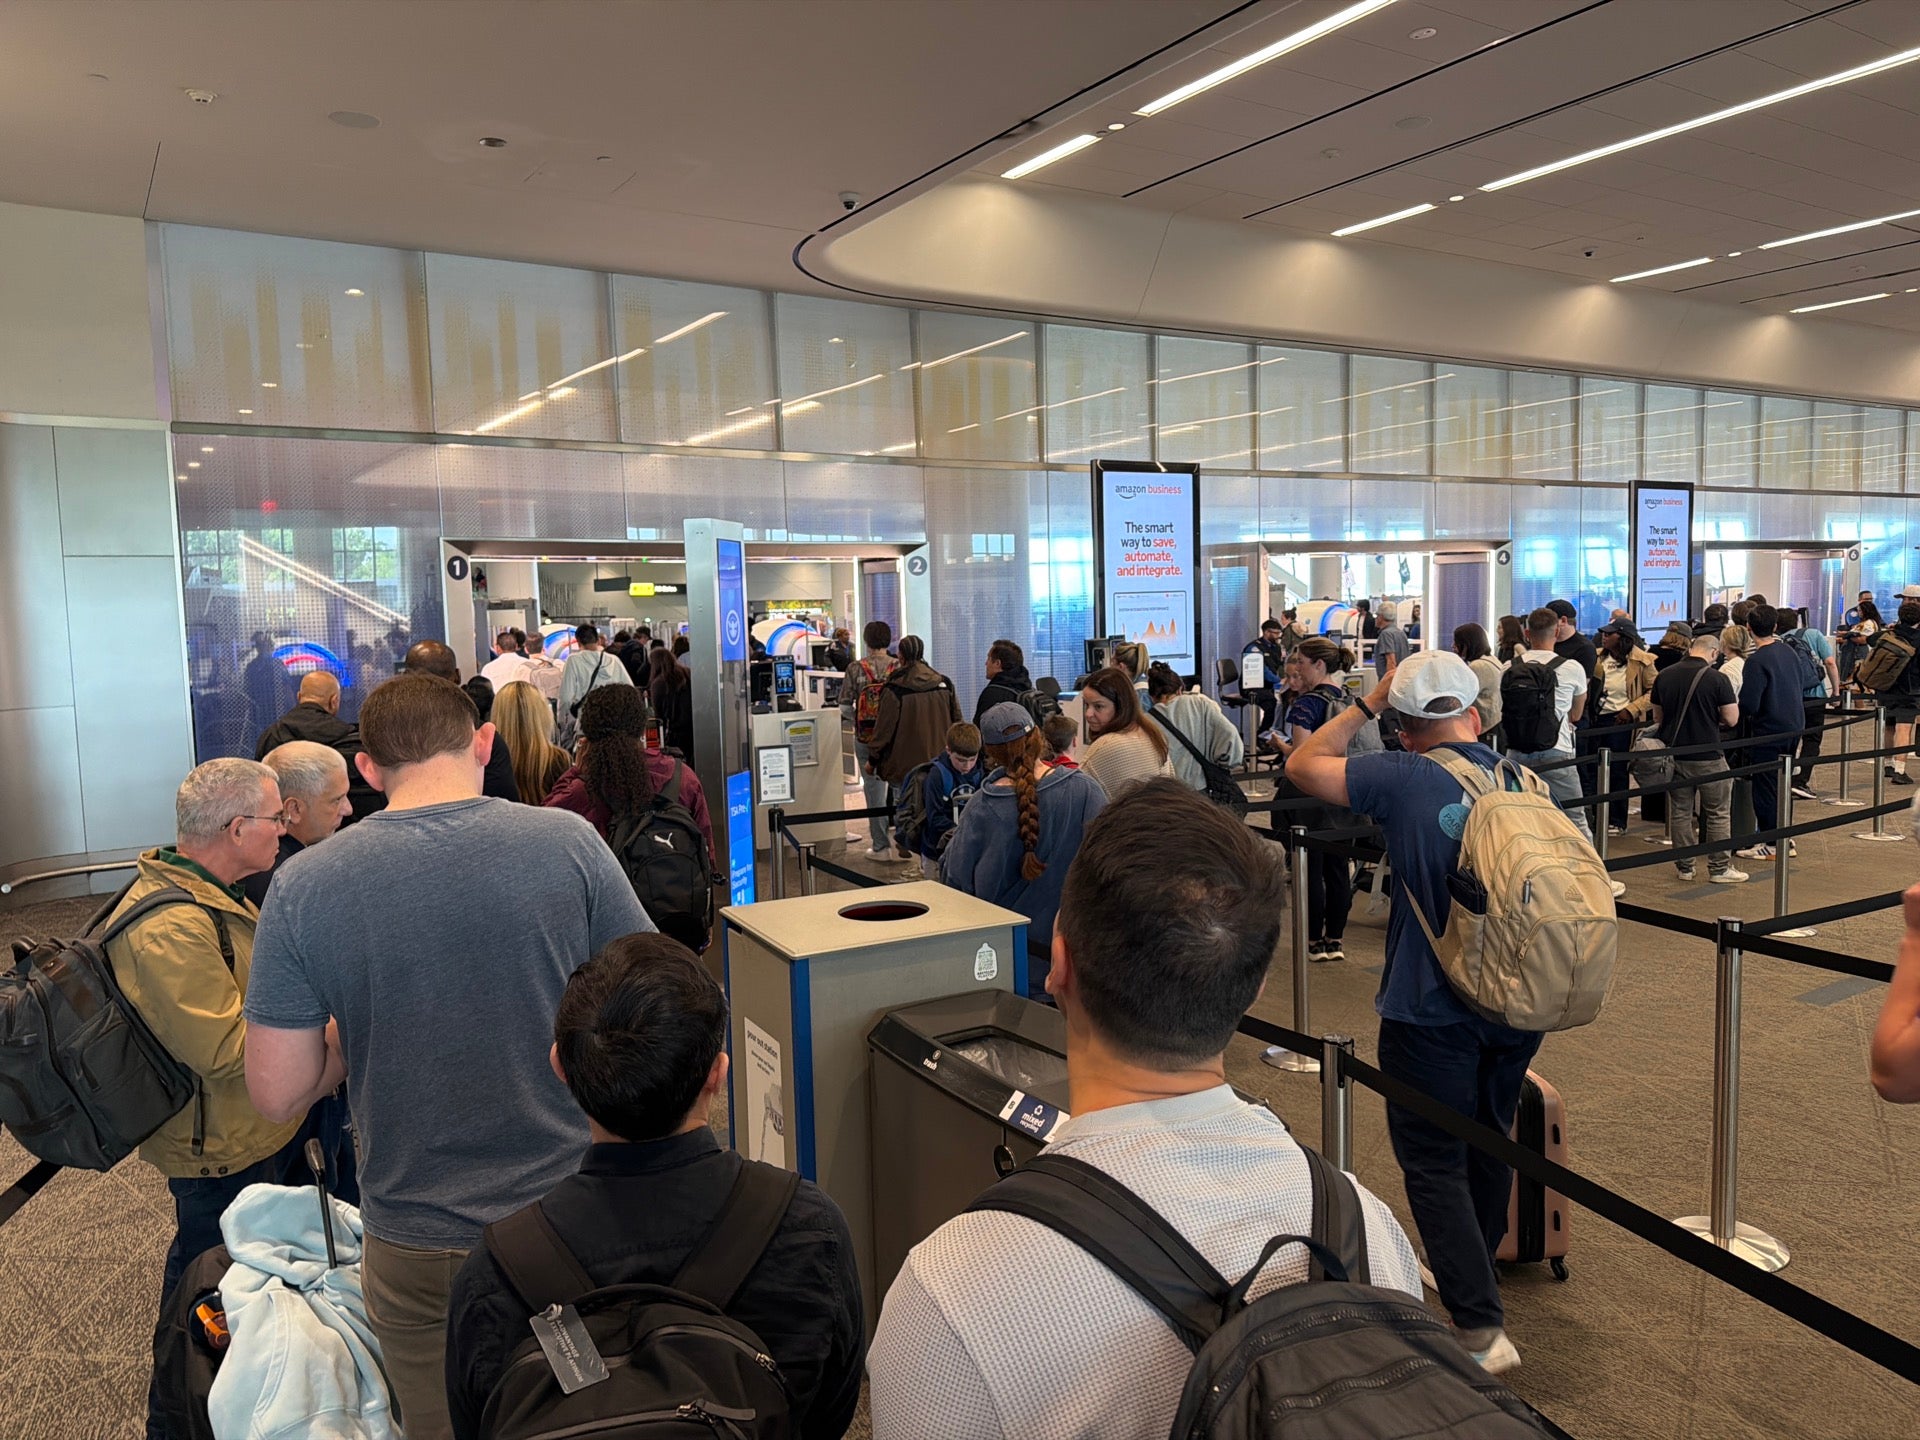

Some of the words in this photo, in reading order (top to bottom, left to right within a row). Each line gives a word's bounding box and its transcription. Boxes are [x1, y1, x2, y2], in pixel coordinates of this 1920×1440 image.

[1115, 484, 1146, 495] amazon
[1147, 484, 1182, 494] business
[1125, 521, 1143, 533] The
[1144, 522, 1174, 533] smart
[1649, 525, 1660, 534] The
[1661, 526, 1677, 535] smart
[1121, 538, 1140, 549] way
[1142, 536, 1152, 547] to
[1153, 538, 1176, 549] save,
[1646, 538, 1658, 547] way
[1659, 537, 1665, 546] to
[1665, 538, 1679, 547] save,
[1124, 550, 1173, 563] automate,
[1644, 558, 1654, 567] and
[452, 560, 461, 576] 1
[912, 559, 923, 573] 2
[1117, 565, 1135, 577] and
[1136, 564, 1183, 577] integrate.
[764, 1043, 778, 1059] station
[923, 1058, 938, 1071] trash
[1021, 1111, 1046, 1128] mixed
[1020, 1119, 1039, 1134] recycling
[564, 1352, 584, 1384] PLATINUM
